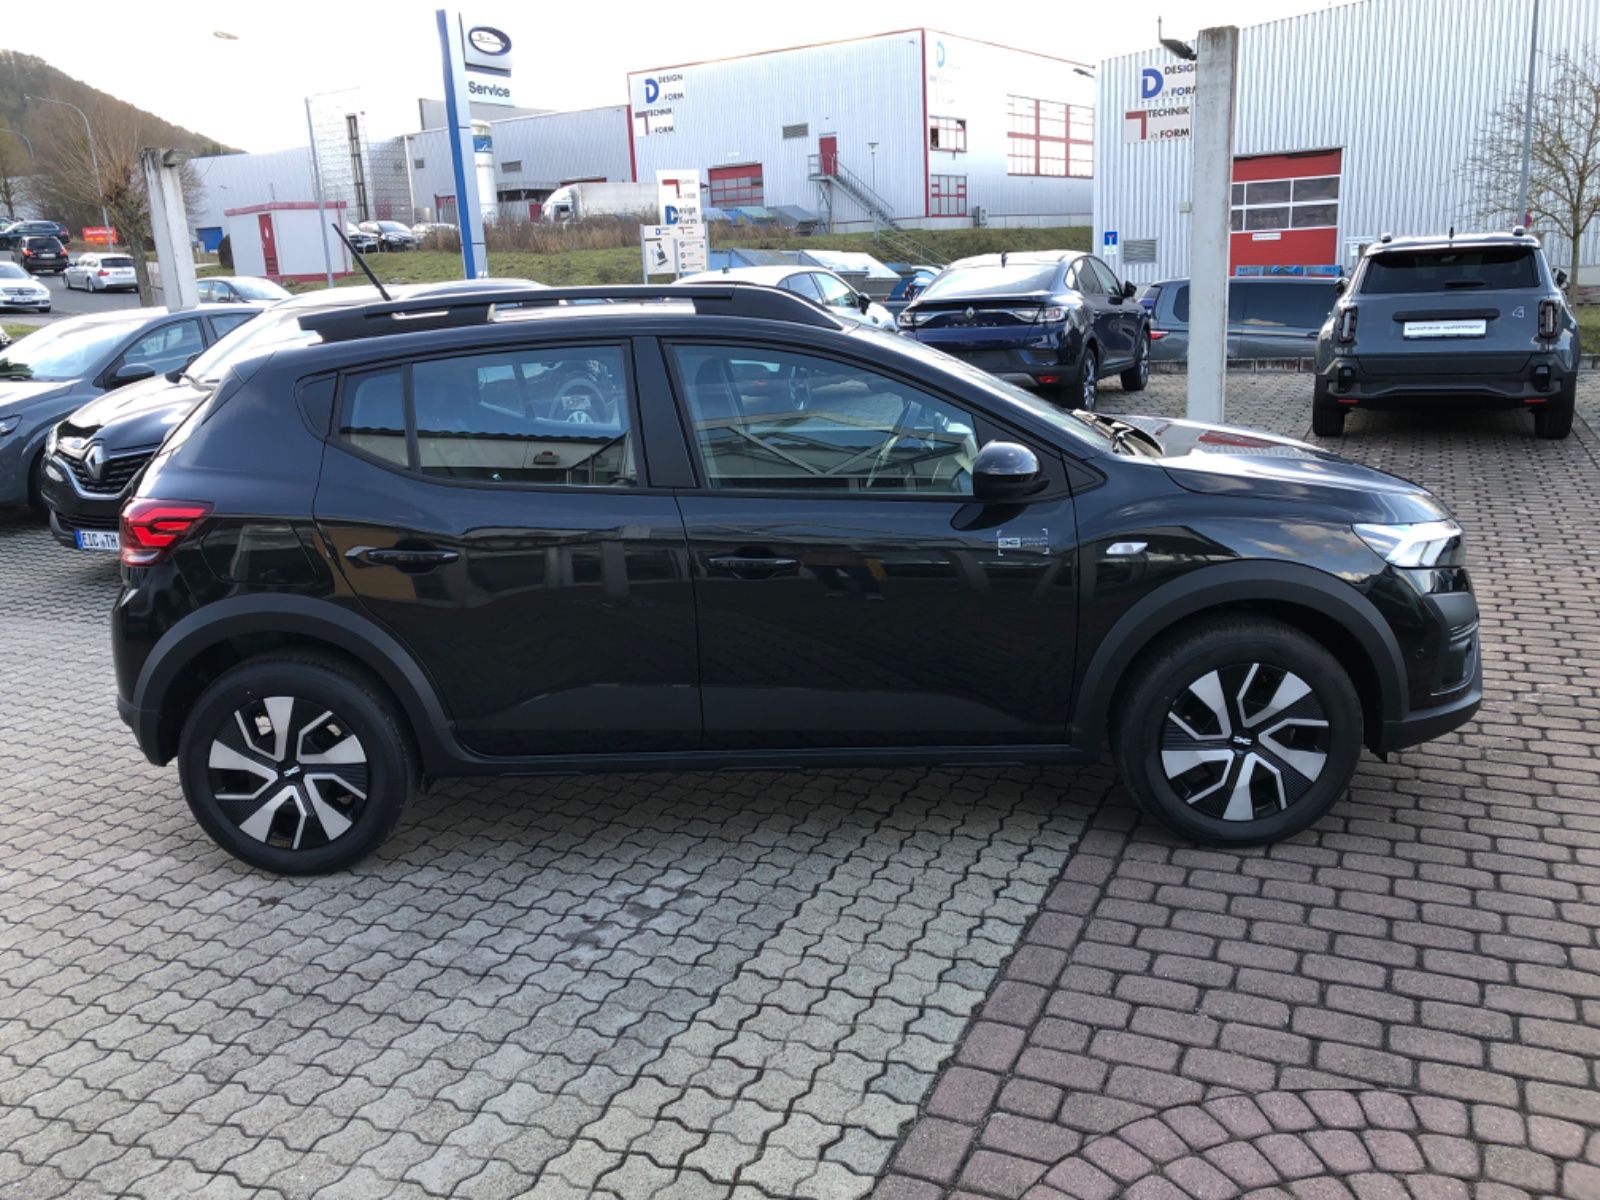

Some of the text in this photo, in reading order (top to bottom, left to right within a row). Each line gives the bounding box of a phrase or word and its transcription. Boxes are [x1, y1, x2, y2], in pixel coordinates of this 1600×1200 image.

[468, 81, 510, 97] Service
[645, 78, 659, 103] D
[1142, 68, 1164, 98] D
[1148, 106, 1190, 118] TECHNIK
[1160, 128, 1190, 139] FORM
